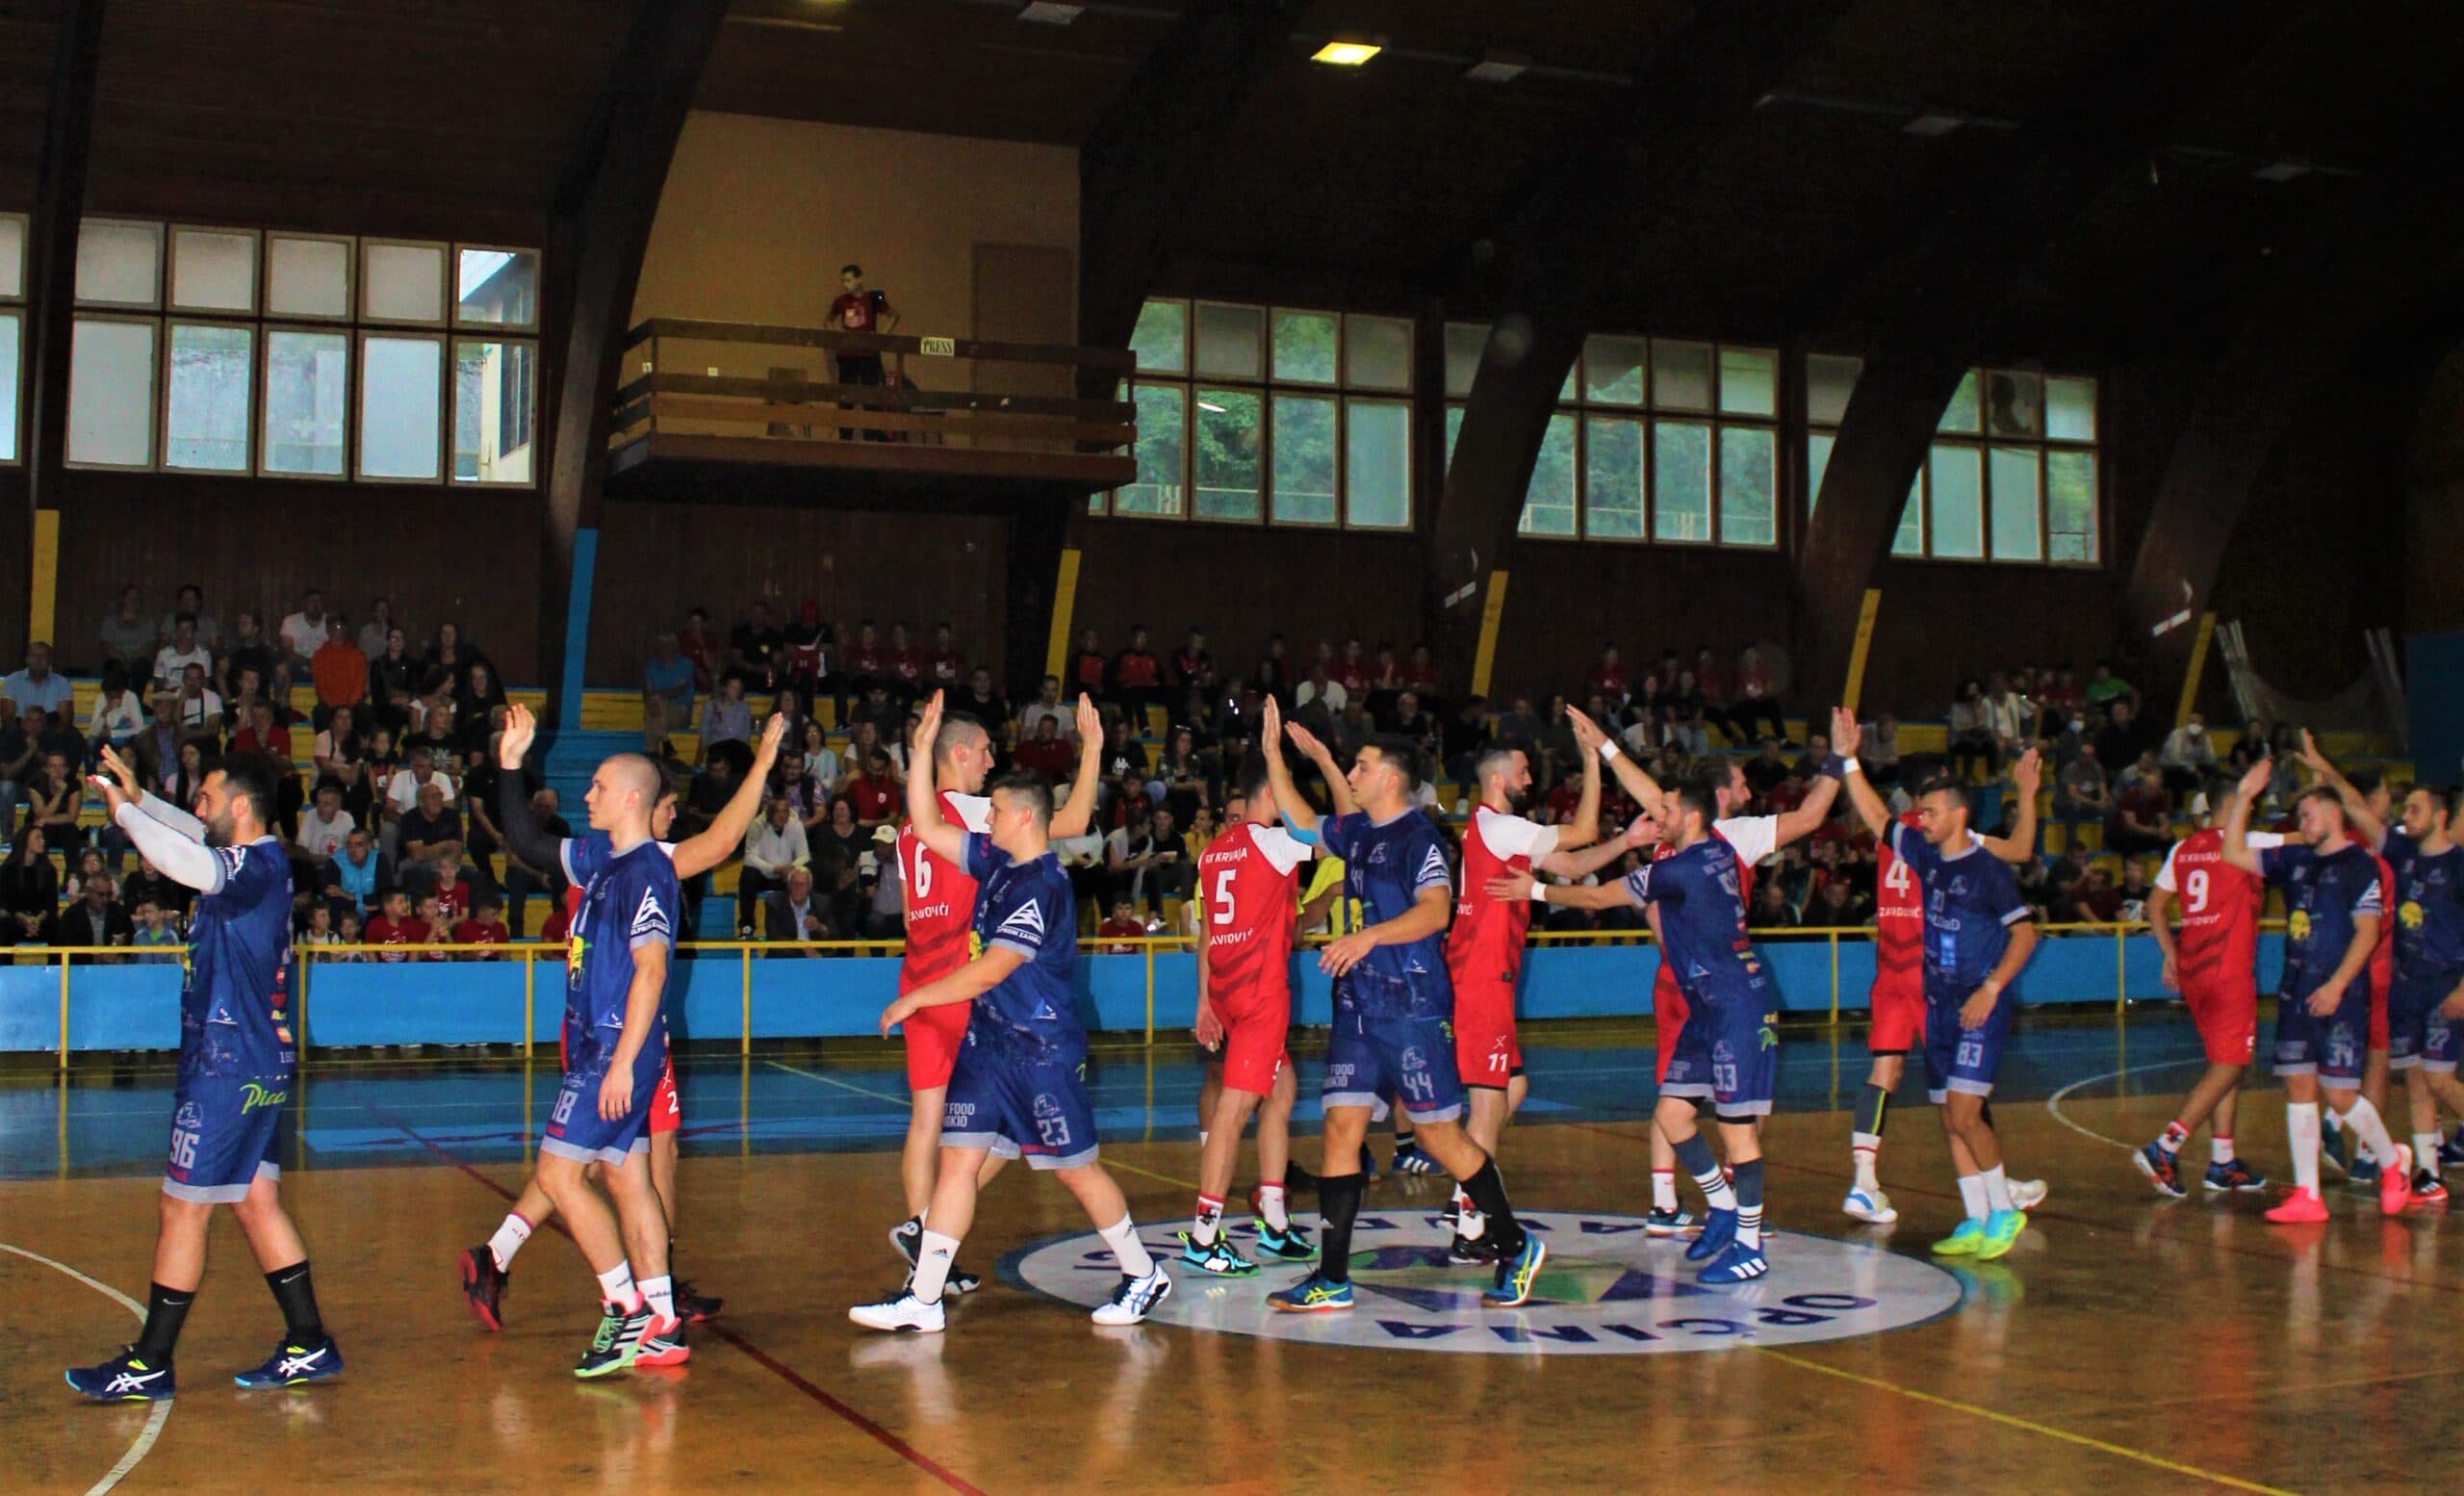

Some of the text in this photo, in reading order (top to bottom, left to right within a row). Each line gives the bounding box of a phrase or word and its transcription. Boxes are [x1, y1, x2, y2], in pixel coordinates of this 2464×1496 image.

[924, 339, 952, 353] PRESS
[914, 841, 932, 898] 6
[1885, 859, 1911, 898] 4
[1214, 868, 1237, 924] 5
[2186, 869, 2209, 914] 9
[1488, 1053, 1507, 1072] 11
[1402, 1072, 1435, 1100] 44
[949, 1102, 975, 1116] FOOD
[169, 1127, 200, 1170] 96
[1038, 1116, 1070, 1147] 23
